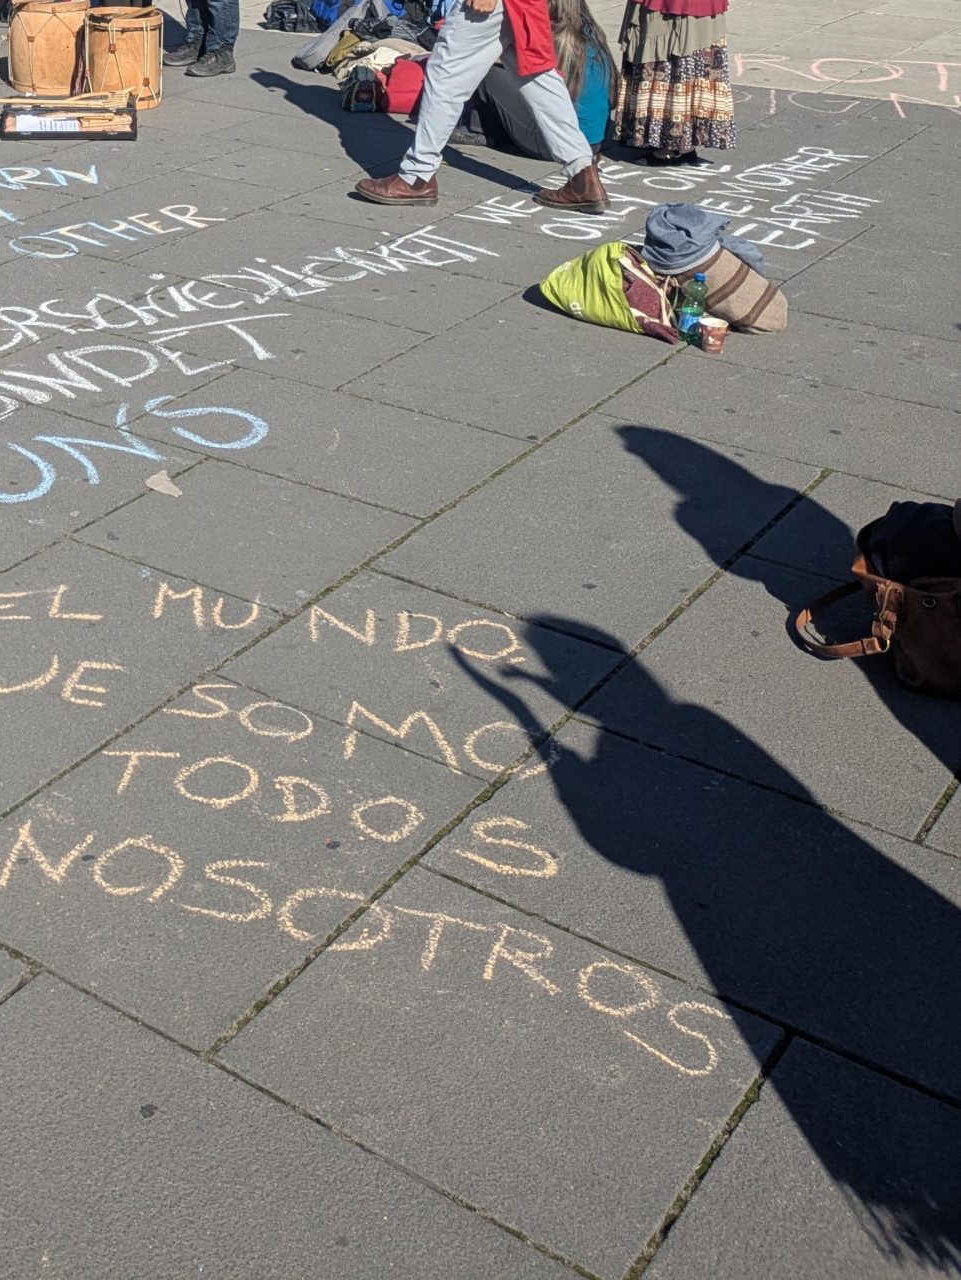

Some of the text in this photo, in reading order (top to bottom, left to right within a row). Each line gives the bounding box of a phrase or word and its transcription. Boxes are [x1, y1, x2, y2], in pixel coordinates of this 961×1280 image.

[706, 146, 870, 203] MOTHER
[7, 204, 226, 259] OTHER
[453, 196, 544, 224] WE
[732, 188, 881, 250] EARTH
